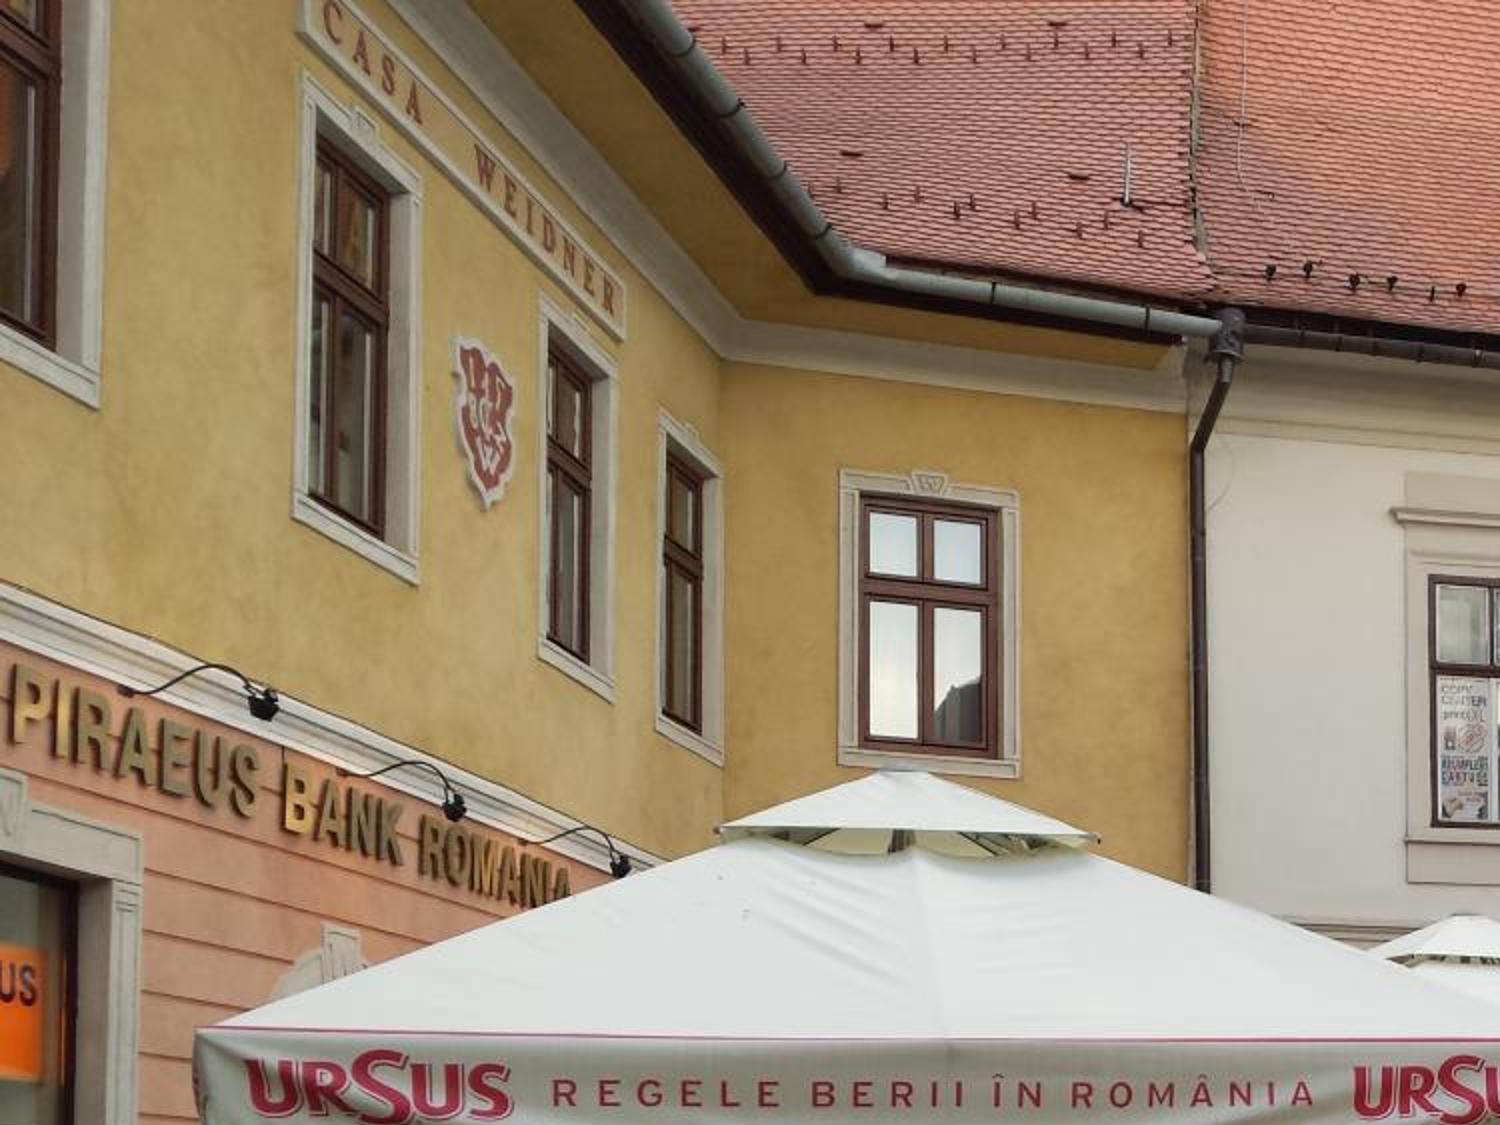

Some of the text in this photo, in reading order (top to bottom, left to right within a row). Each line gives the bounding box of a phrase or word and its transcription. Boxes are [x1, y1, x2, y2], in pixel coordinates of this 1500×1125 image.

[322, 1, 614, 316] CASA WEIDNER
[7, 662, 572, 909] PIRAEUS BANK ROMANIA
[552, 1078, 781, 1108] REGELE
[811, 1080, 965, 1109] BERII
[991, 1073, 1044, 1109] ÎN
[1069, 1073, 1313, 1109] ROMÂNIA
